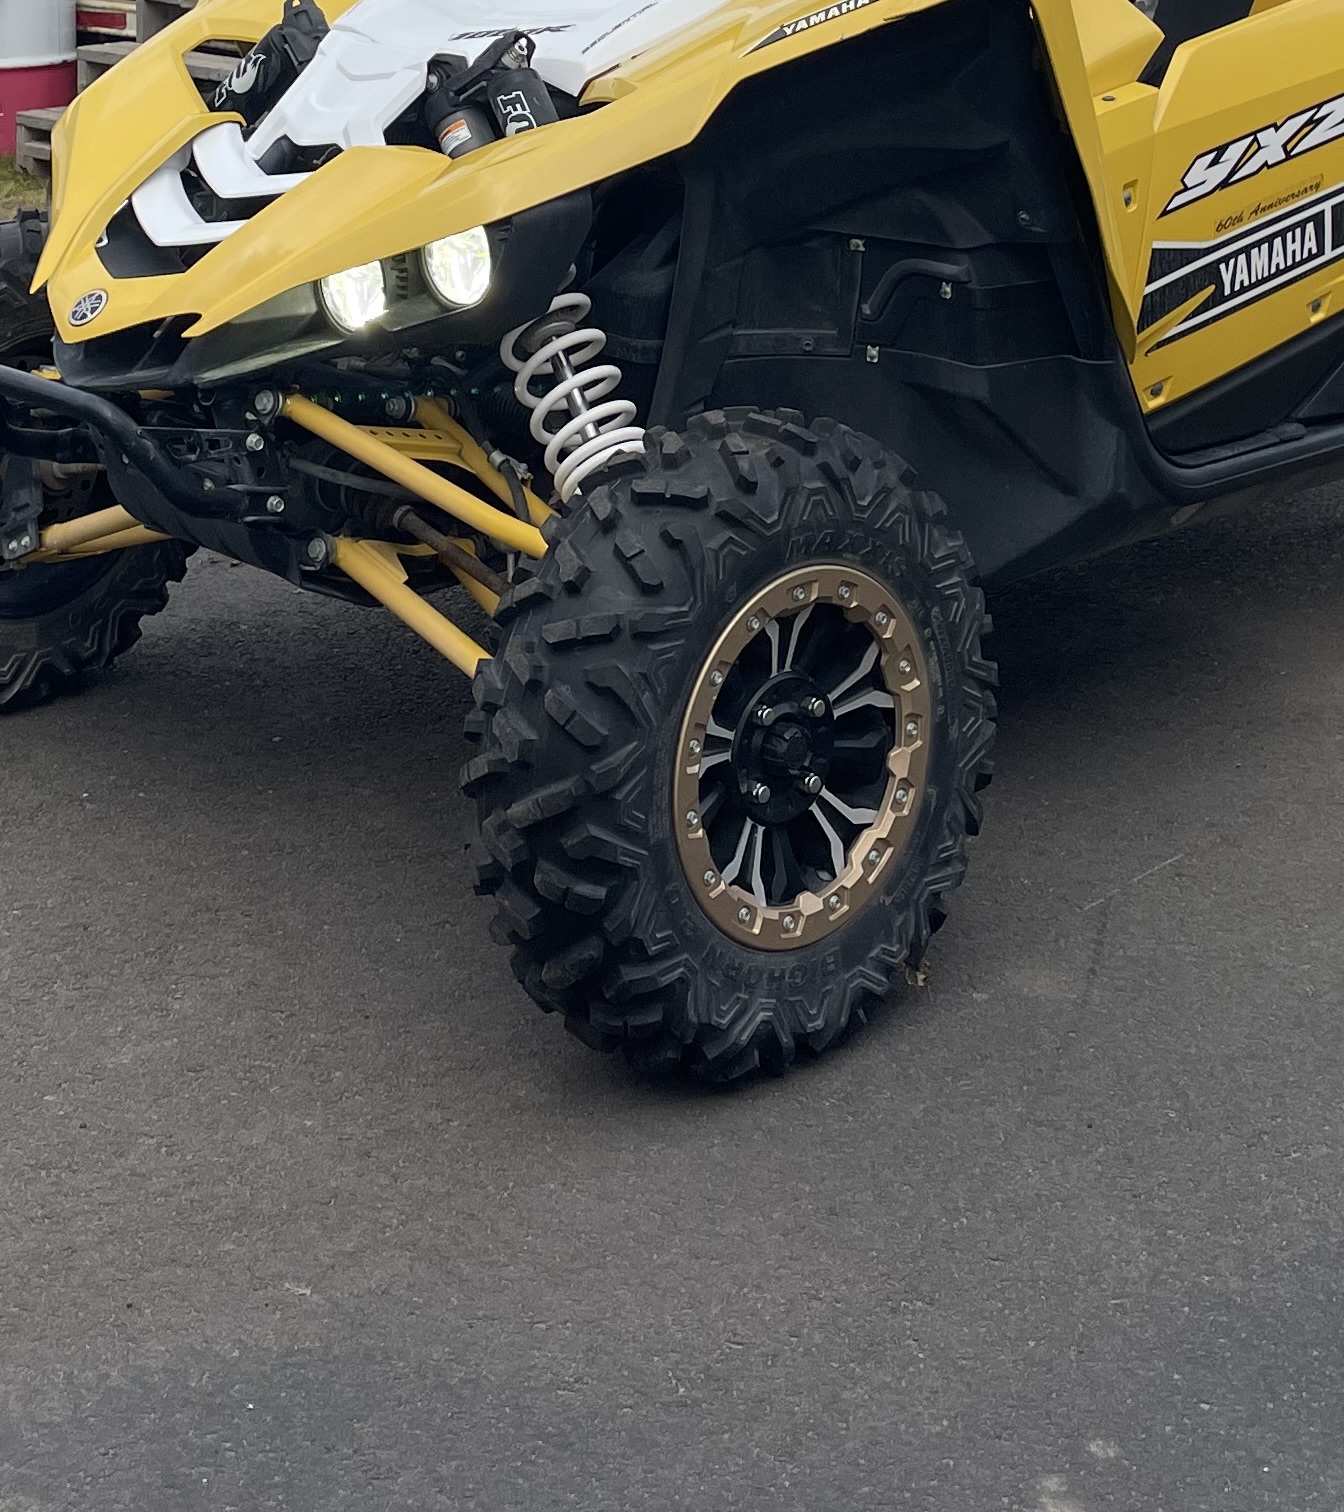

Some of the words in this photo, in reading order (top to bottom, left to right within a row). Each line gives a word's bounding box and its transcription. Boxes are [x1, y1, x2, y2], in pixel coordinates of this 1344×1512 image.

[1216, 210, 1244, 233] 60th
[1248, 181, 1321, 221] Anniversary
[1219, 221, 1318, 296] YAMAHA
